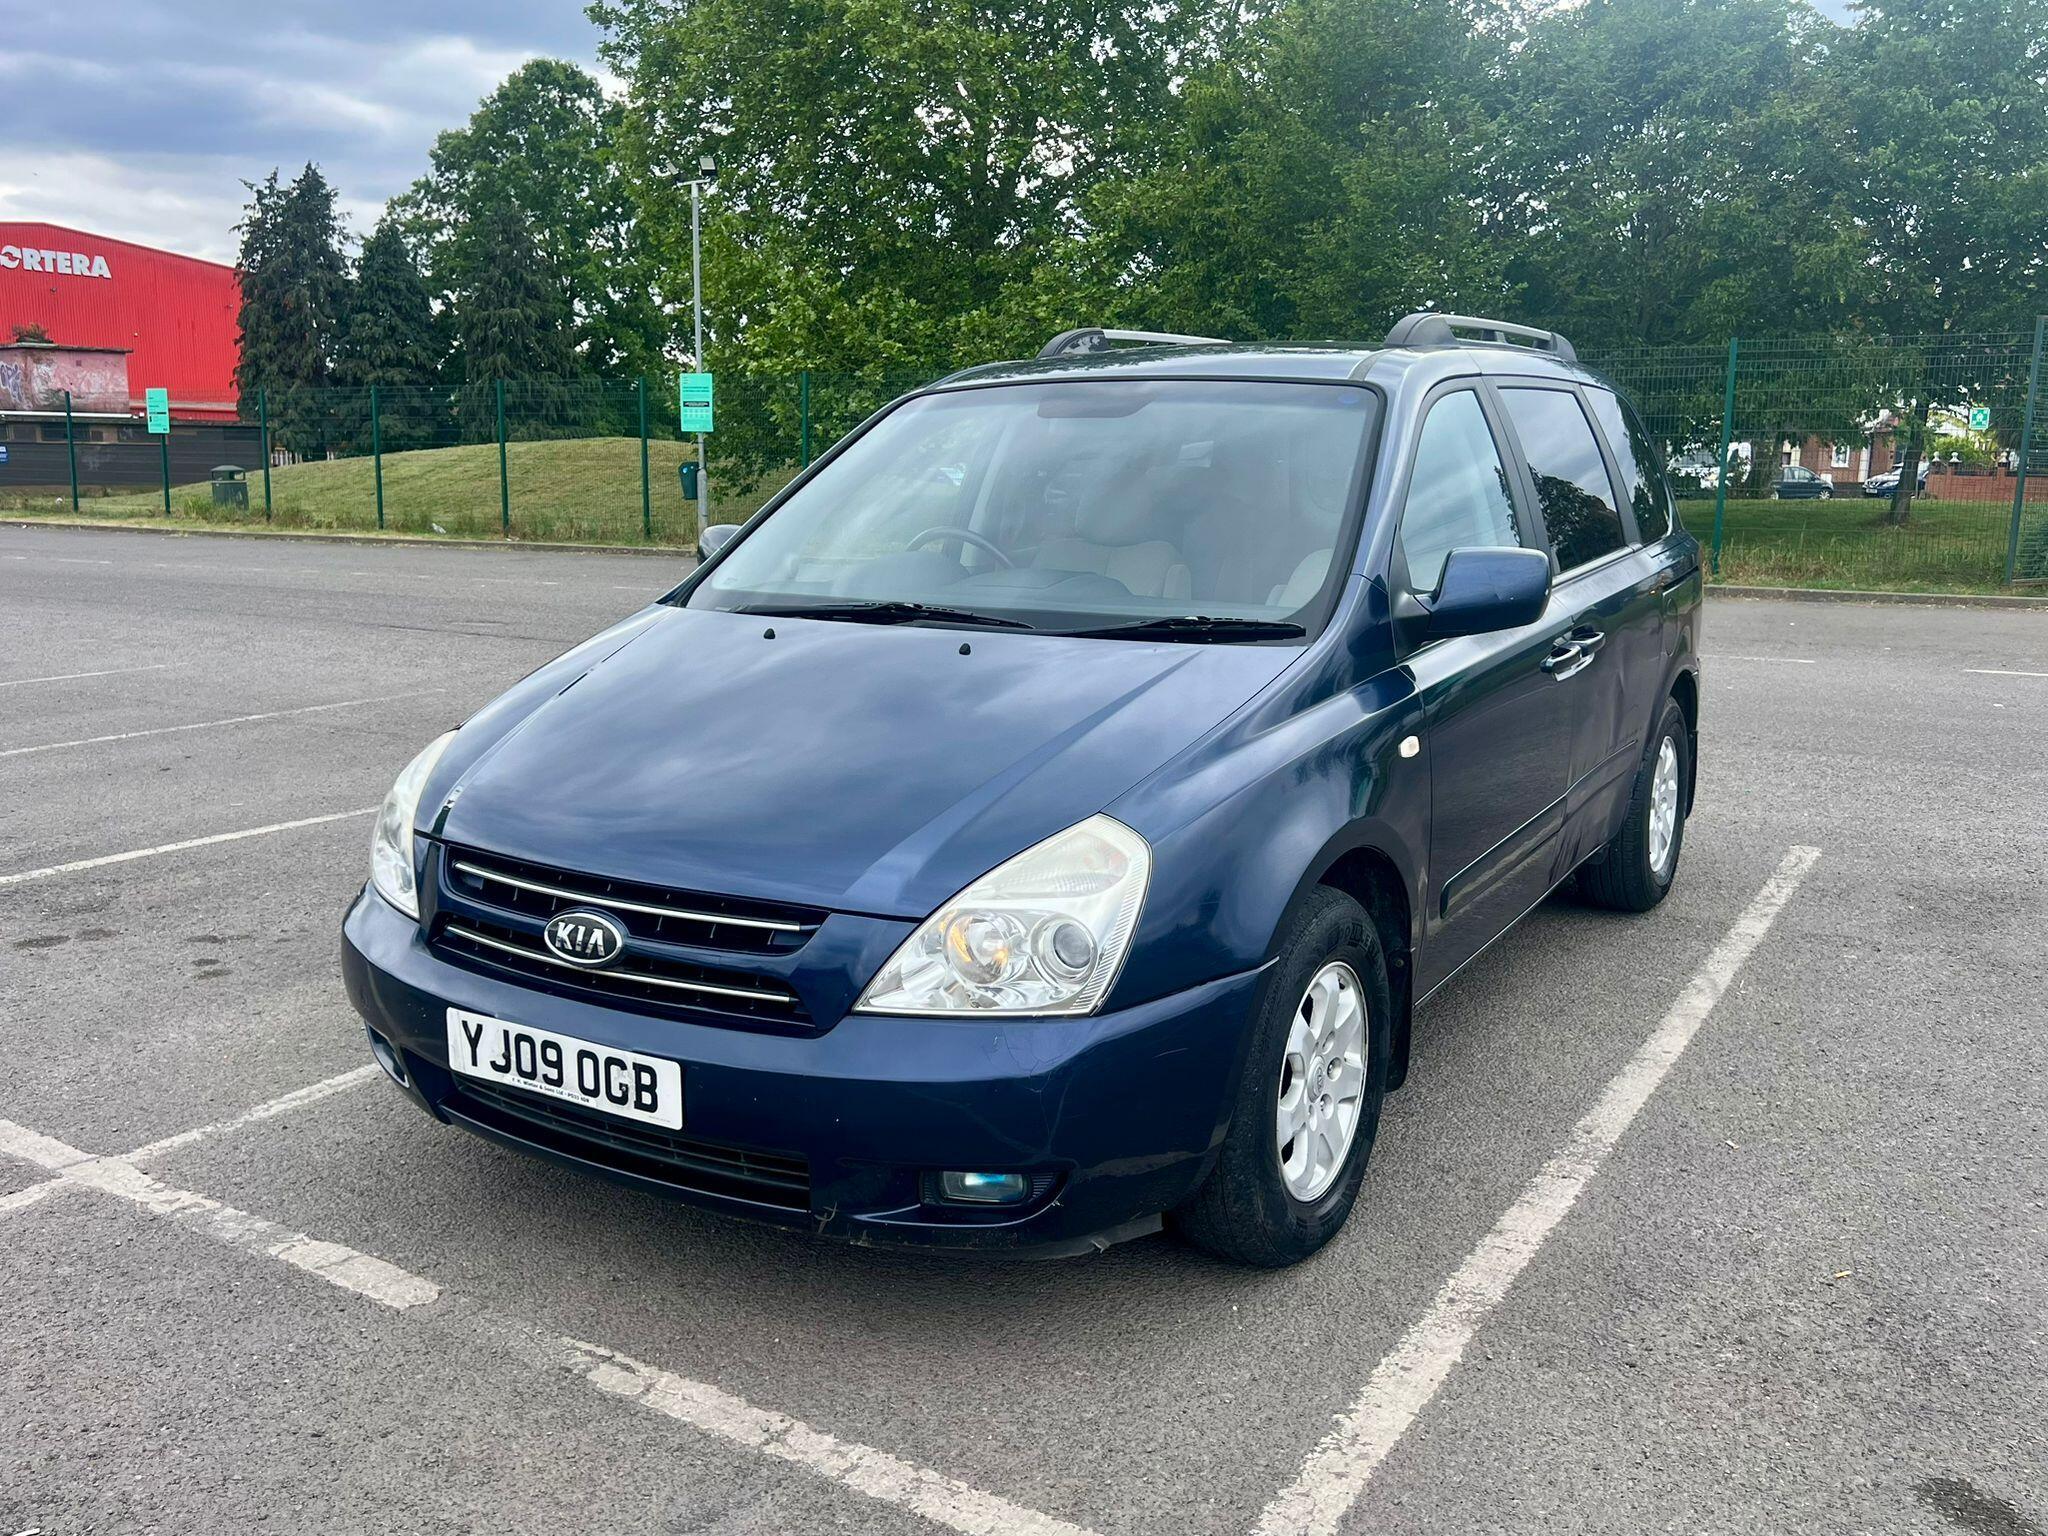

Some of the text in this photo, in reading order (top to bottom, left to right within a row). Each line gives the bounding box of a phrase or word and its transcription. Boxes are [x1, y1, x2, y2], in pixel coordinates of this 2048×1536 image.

[555, 921, 606, 957] KIA
[461, 1020, 658, 1113] YJ09 OGB
